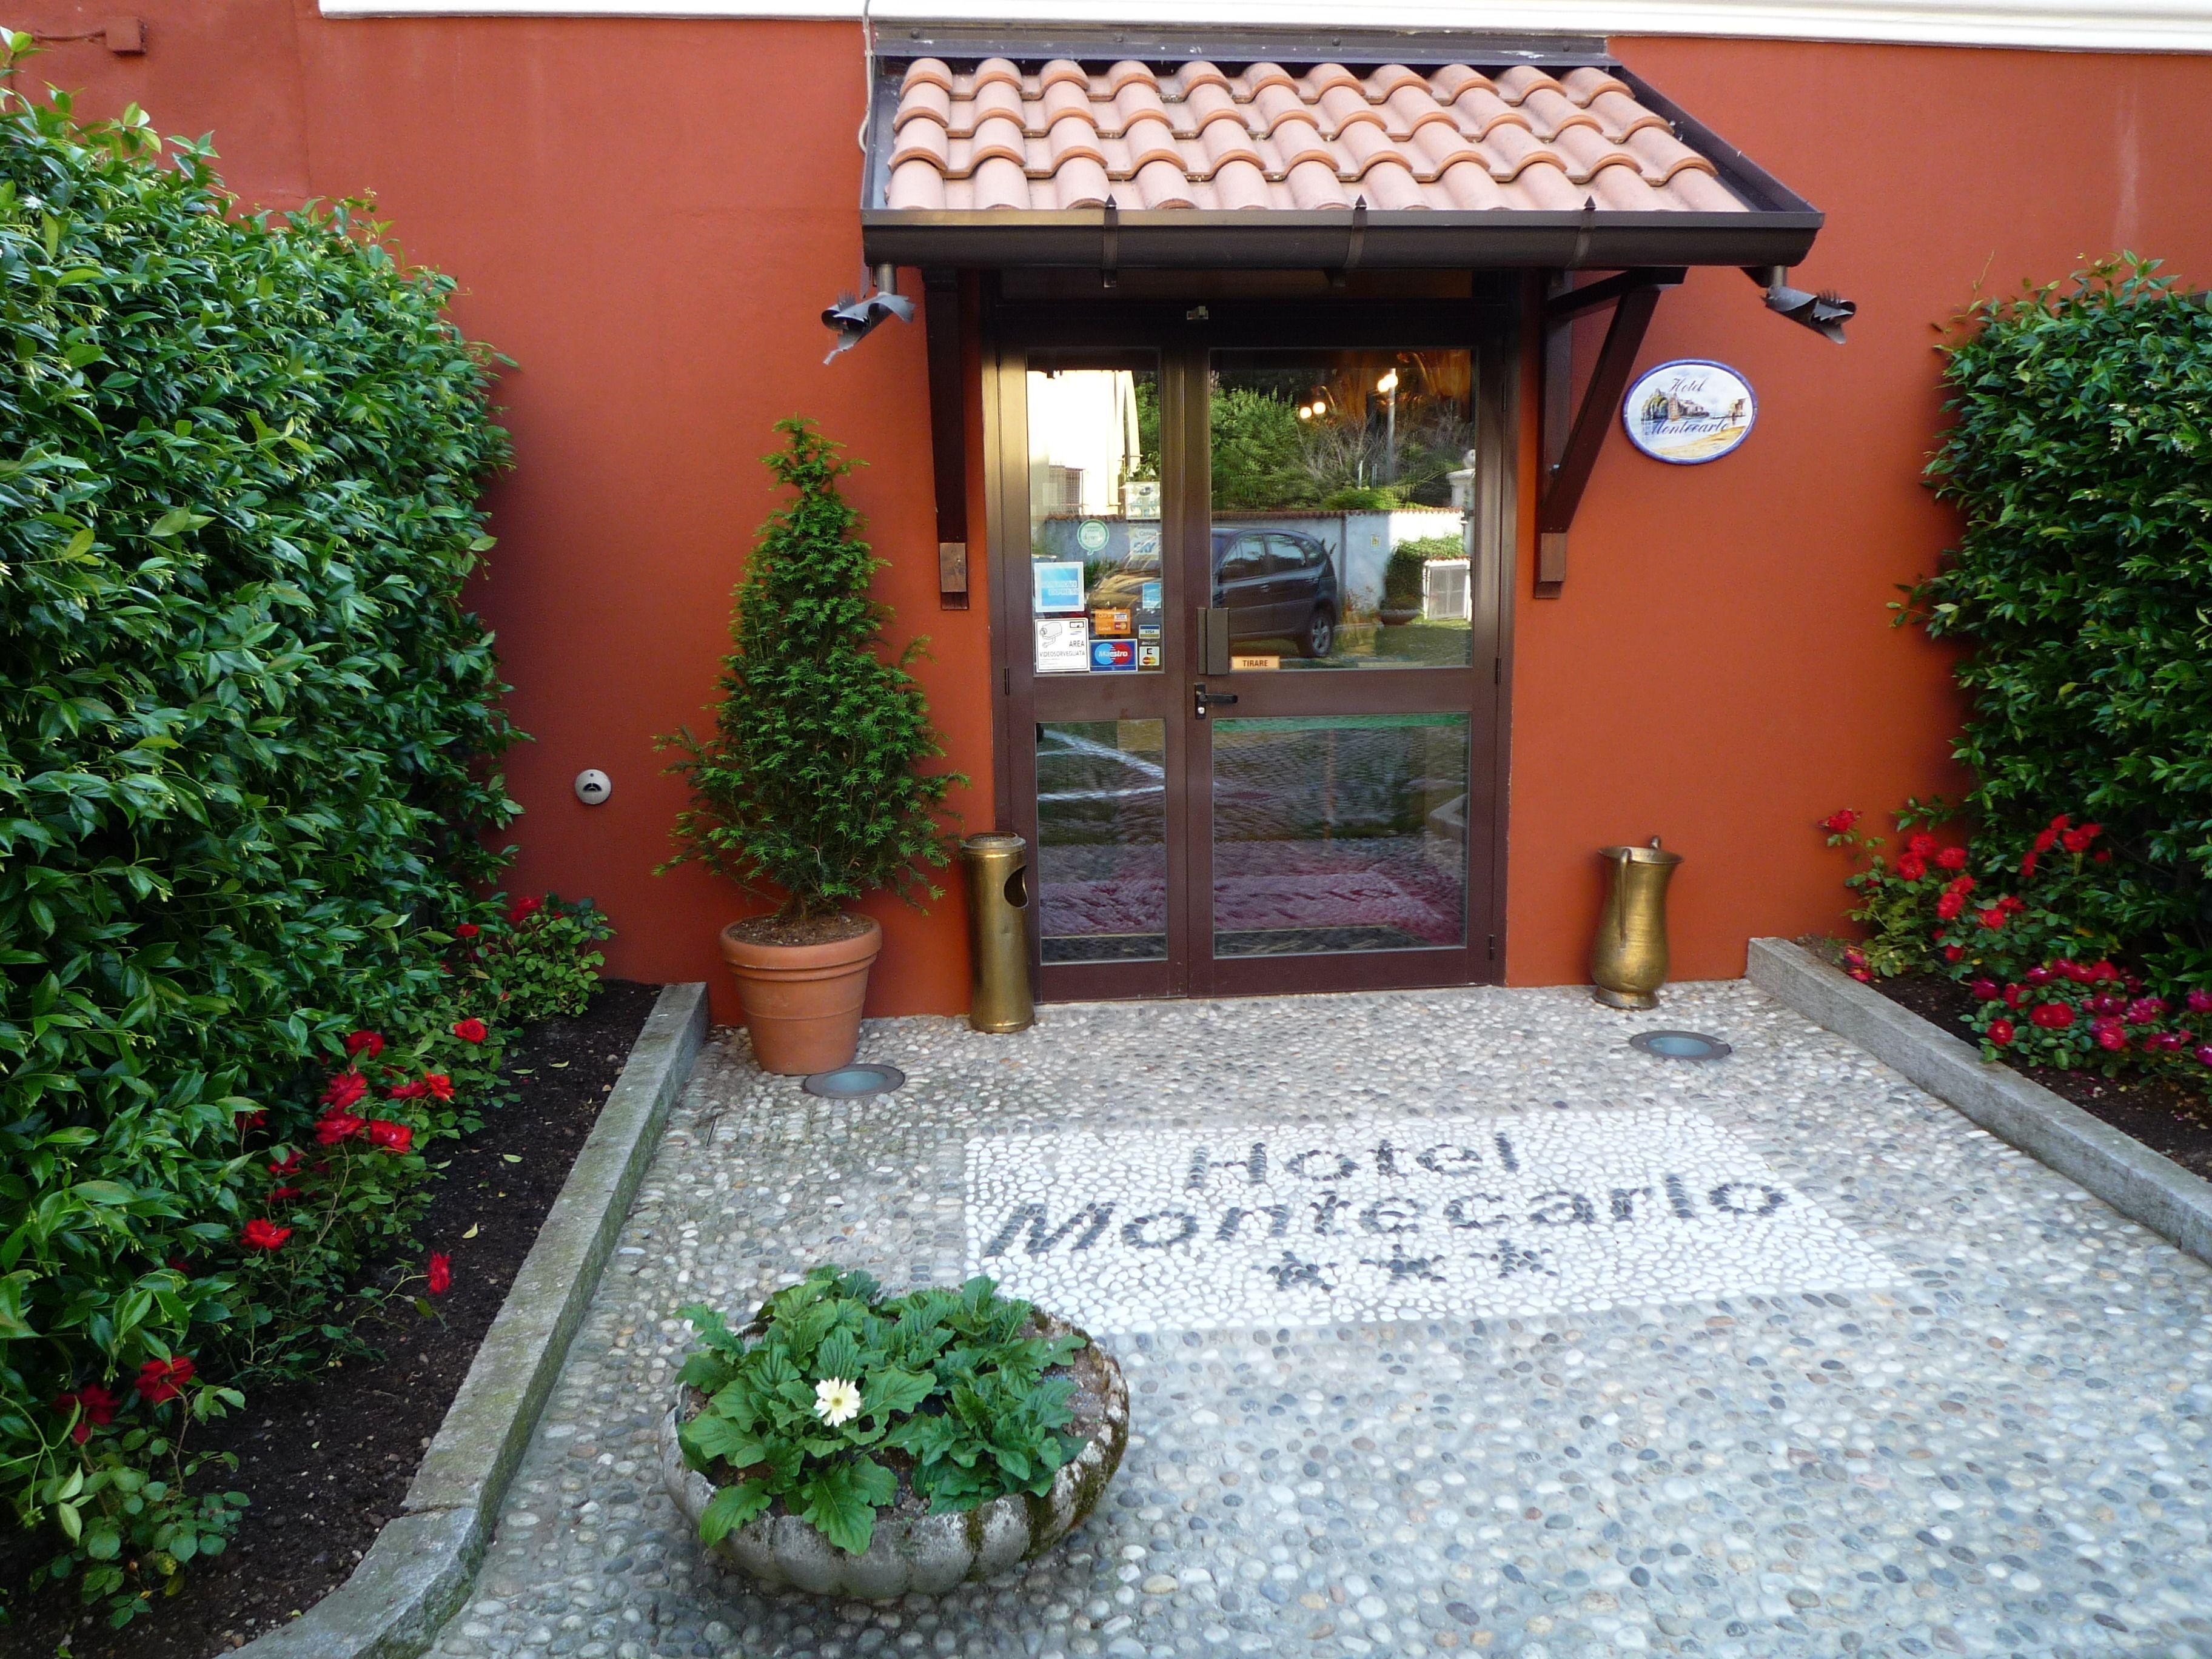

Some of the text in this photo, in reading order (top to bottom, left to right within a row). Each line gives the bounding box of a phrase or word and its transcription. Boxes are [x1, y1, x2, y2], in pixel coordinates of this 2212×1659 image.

[1669, 377, 1708, 393] Hotel
[1644, 417, 1728, 436] Montecarlo
[1186, 1131, 1518, 1190] Hotel
[985, 1173, 1786, 1257] Montecarlo
